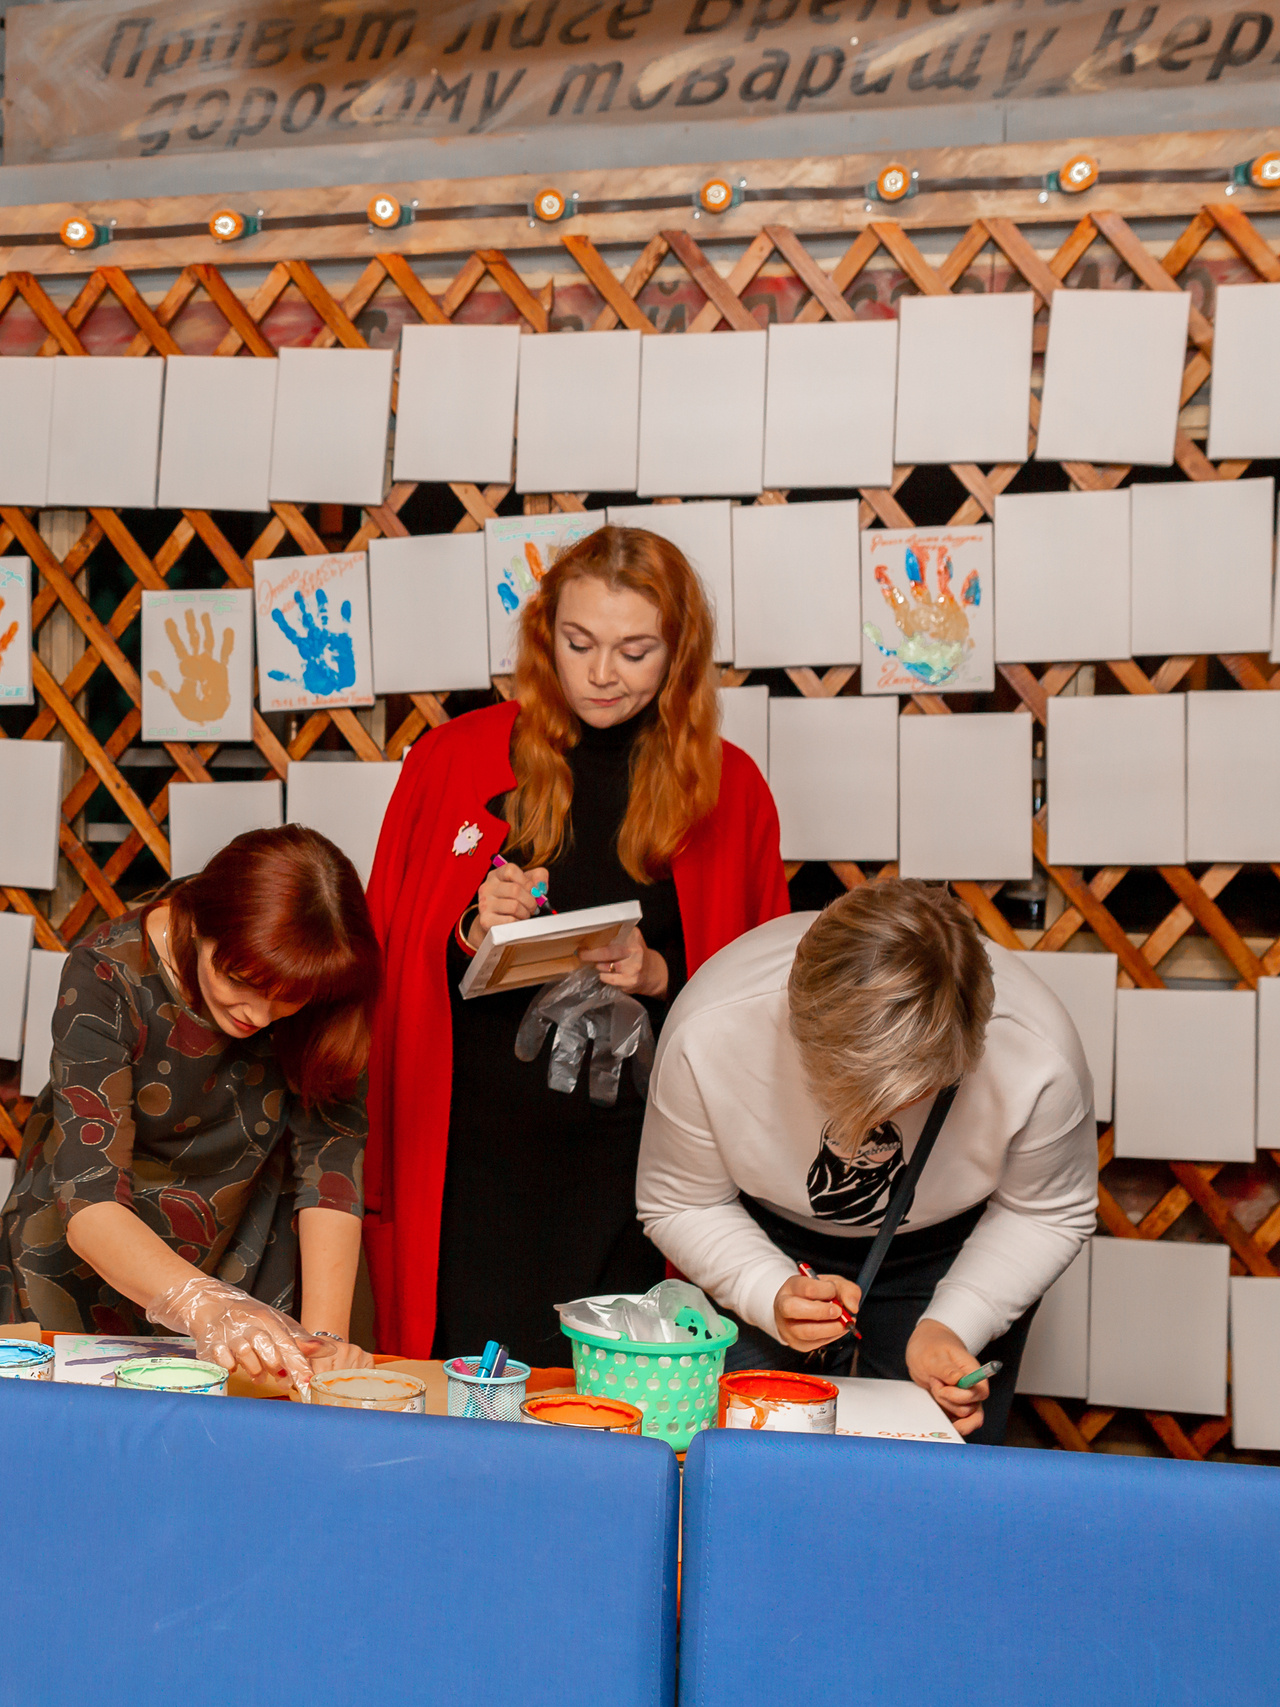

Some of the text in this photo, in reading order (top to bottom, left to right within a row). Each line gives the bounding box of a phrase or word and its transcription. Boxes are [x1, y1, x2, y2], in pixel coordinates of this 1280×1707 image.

[101, 9, 418, 88] Привет
[138, 67, 527, 158] дорогому
[1086, 5, 1280, 81] Кер
